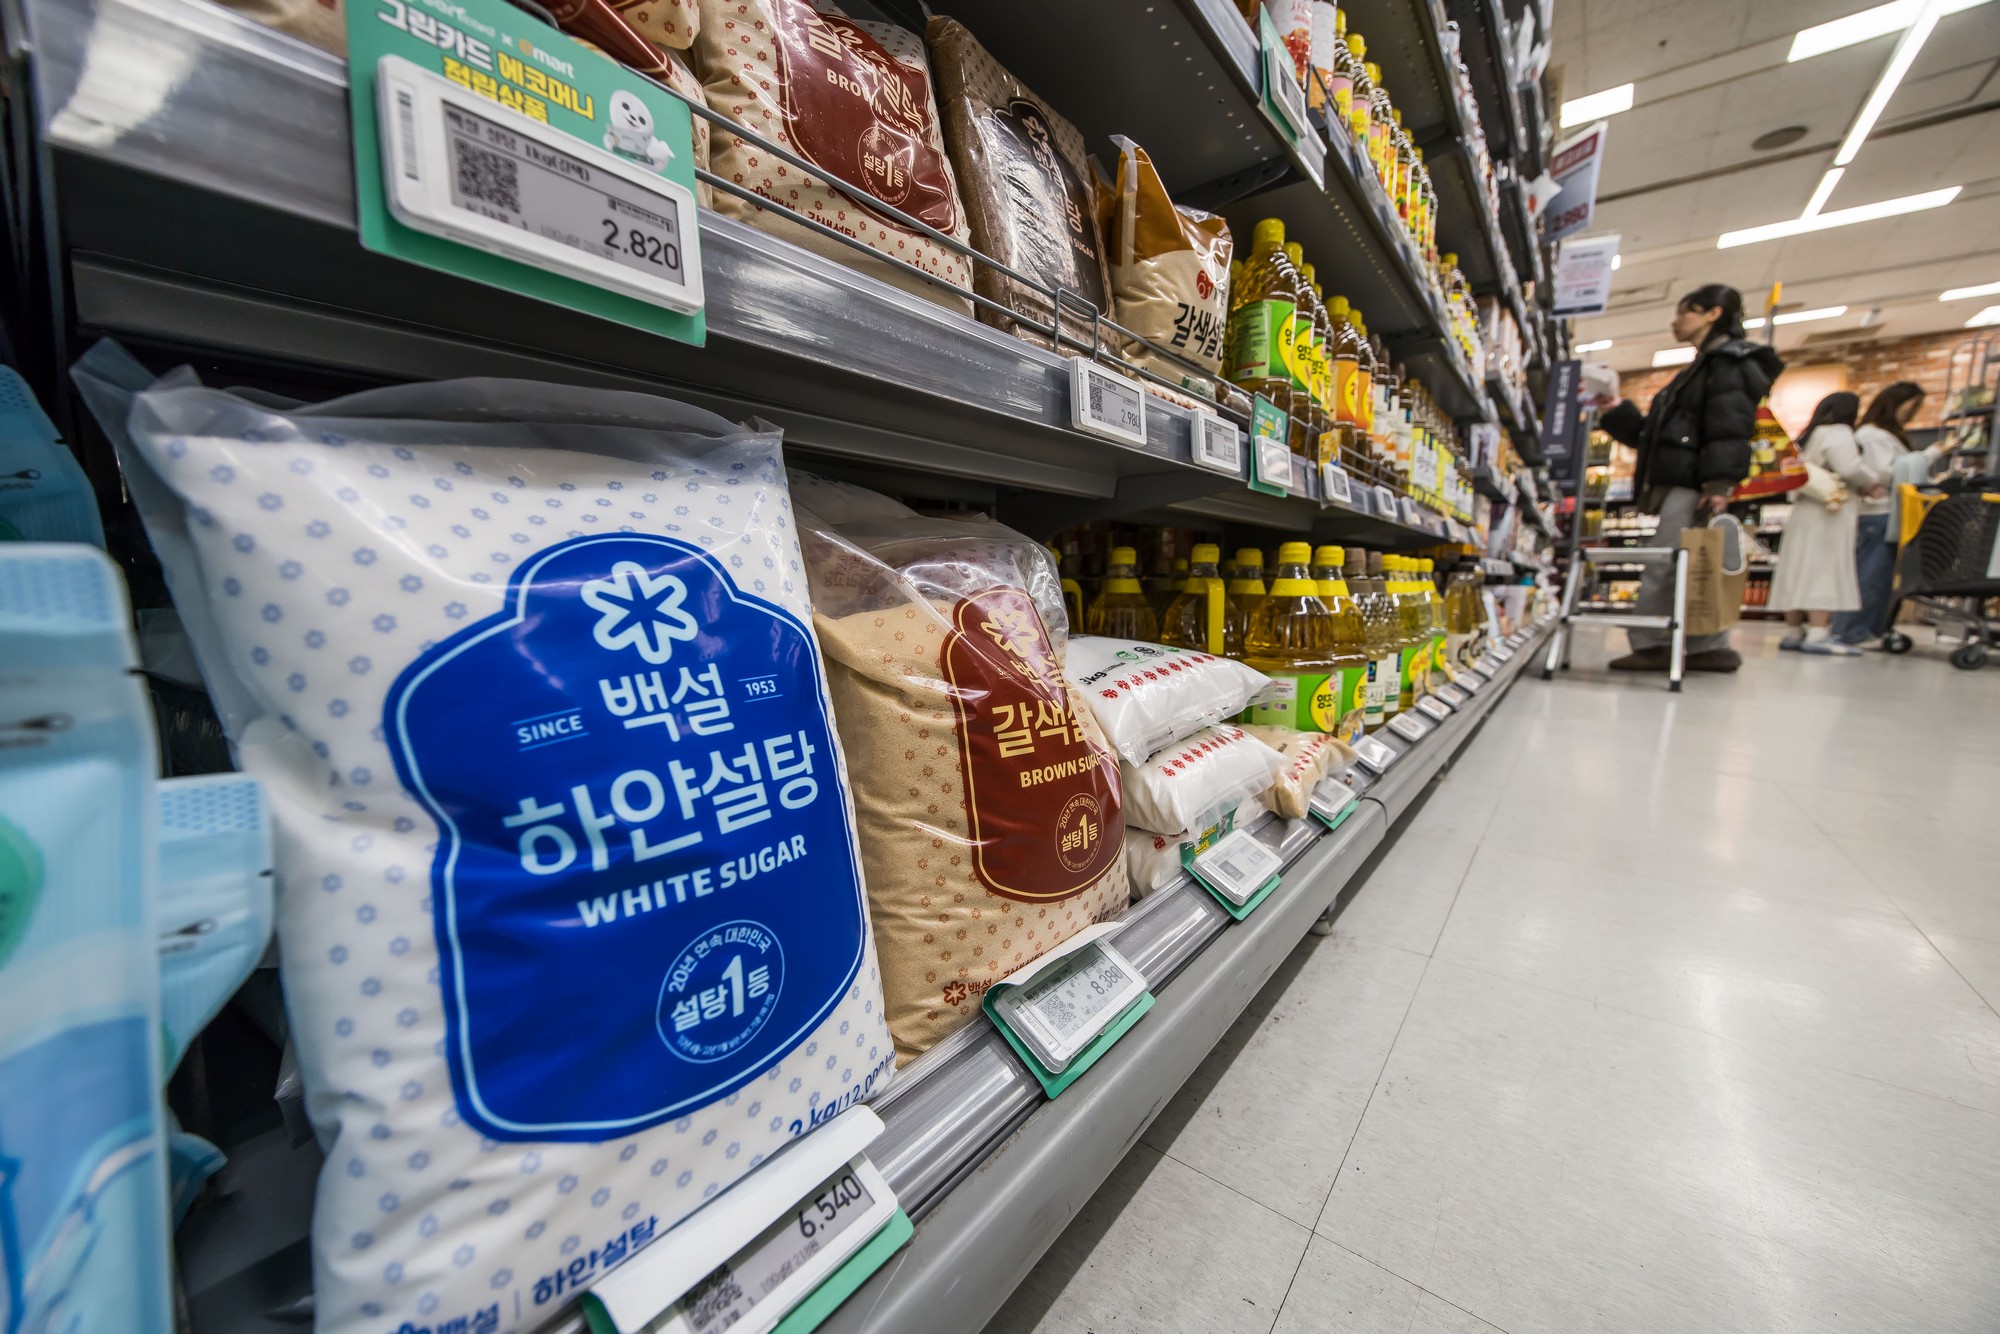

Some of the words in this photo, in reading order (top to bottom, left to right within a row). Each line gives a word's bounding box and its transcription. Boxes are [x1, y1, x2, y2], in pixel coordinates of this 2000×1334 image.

[377, 0, 494, 72] 그린카드
[497, 50, 595, 121] 에코머니
[516, 713, 584, 745] SINCE
[744, 680, 777, 697] 1953
[598, 662, 734, 743] 백설
[504, 730, 820, 876] 하얀설탕
[1020, 755, 1077, 788] BROWN
[577, 866, 715, 928] WHITE
[719, 834, 808, 890] SUGAR
[668, 953, 699, 994] 20년
[694, 933, 724, 959] 연속
[724, 926, 772, 955] 대한민국
[798, 1174, 862, 1238] 6,540
[532, 1214, 660, 1306] 하얀설탕
